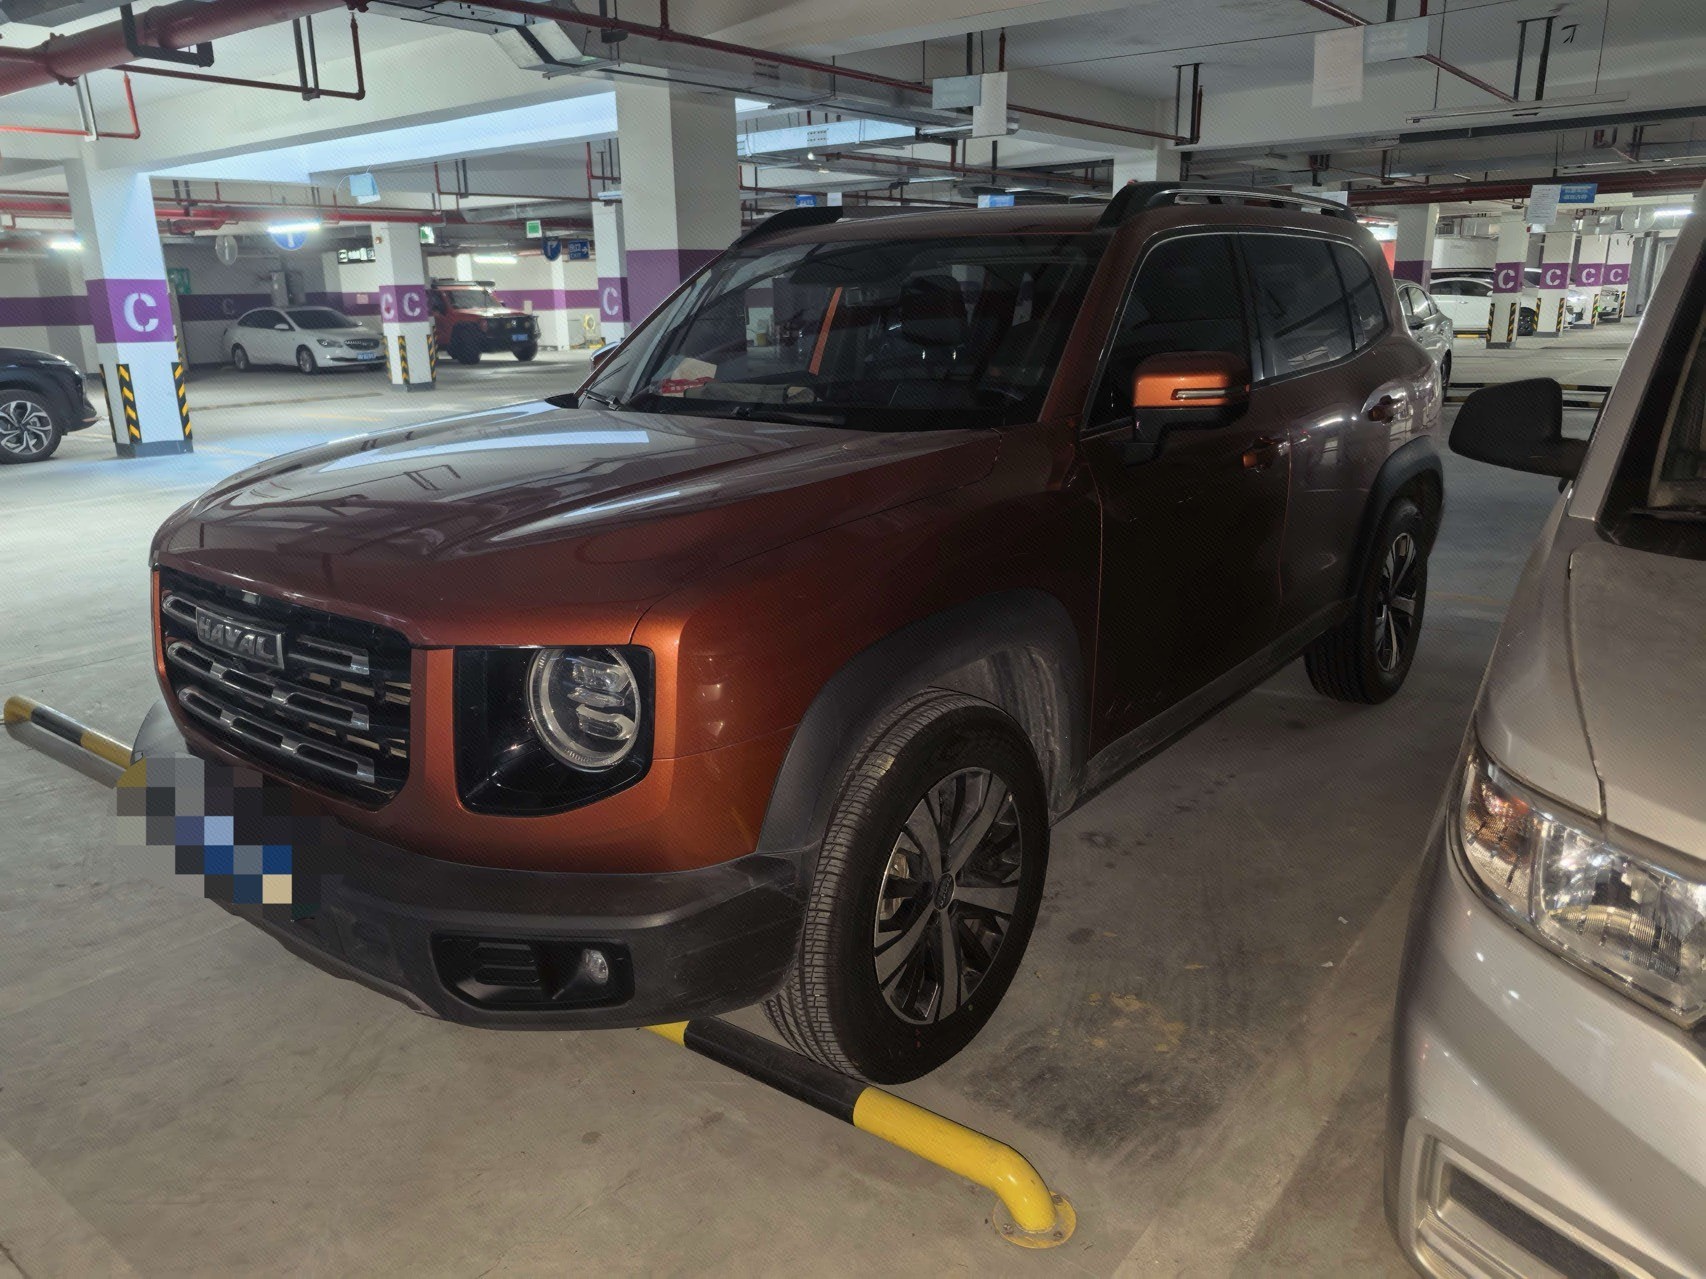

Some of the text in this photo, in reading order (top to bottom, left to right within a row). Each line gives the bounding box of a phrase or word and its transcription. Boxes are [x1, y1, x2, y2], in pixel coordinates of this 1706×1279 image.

[1498, 269, 1515, 290] C
[1546, 268, 1561, 286] C
[1581, 268, 1596, 284] C
[1610, 268, 1623, 282] C
[124, 292, 159, 332] C
[381, 293, 395, 320] C
[403, 292, 420, 317] C
[603, 287, 619, 316] C
[199, 616, 276, 660] HAVAL
